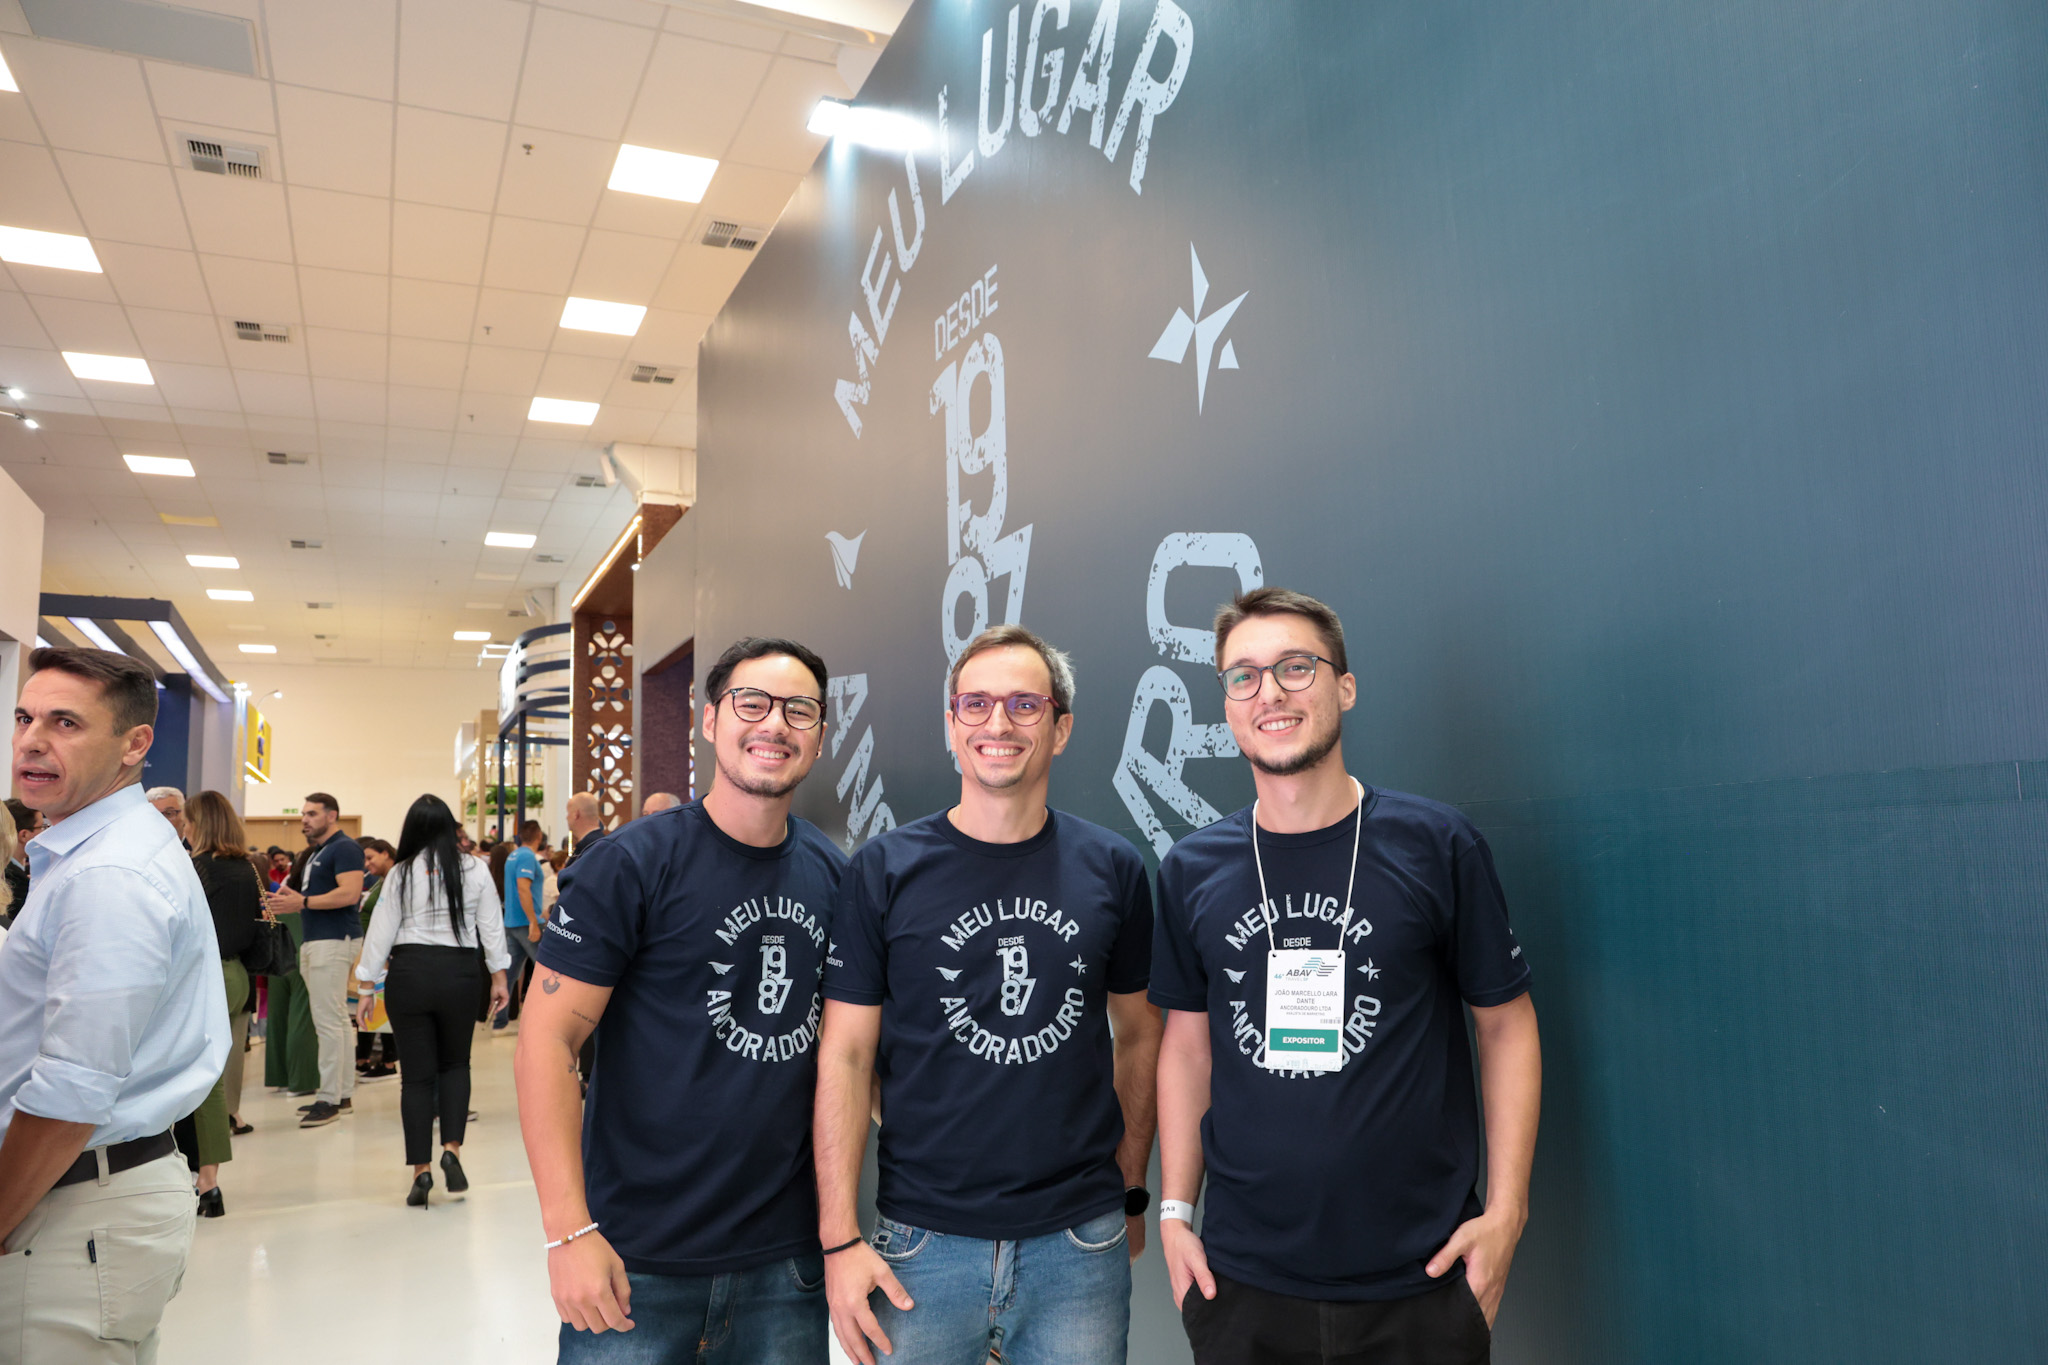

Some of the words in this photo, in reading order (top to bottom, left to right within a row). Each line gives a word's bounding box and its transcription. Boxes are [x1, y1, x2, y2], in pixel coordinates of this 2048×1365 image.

[834, 148, 926, 440] MEU
[937, 0, 1194, 206] LUGAR
[935, 264, 999, 361] DESDE
[715, 899, 762, 947] MEU
[763, 896, 826, 949] LUGAR
[762, 935, 785, 944] DESDE
[940, 903, 994, 952] MEU
[997, 896, 1080, 943] LUGAR
[997, 935, 1025, 947] DESDE
[1225, 898, 1280, 951] MEU
[1285, 892, 1373, 945] LUGAR
[1283, 936, 1311, 948] DESDE
[707, 990, 824, 1062] ANCORADOURO
[939, 987, 1085, 1065] ANCORADOURO
[1282, 1036, 1325, 1045] EXPOSITOR
